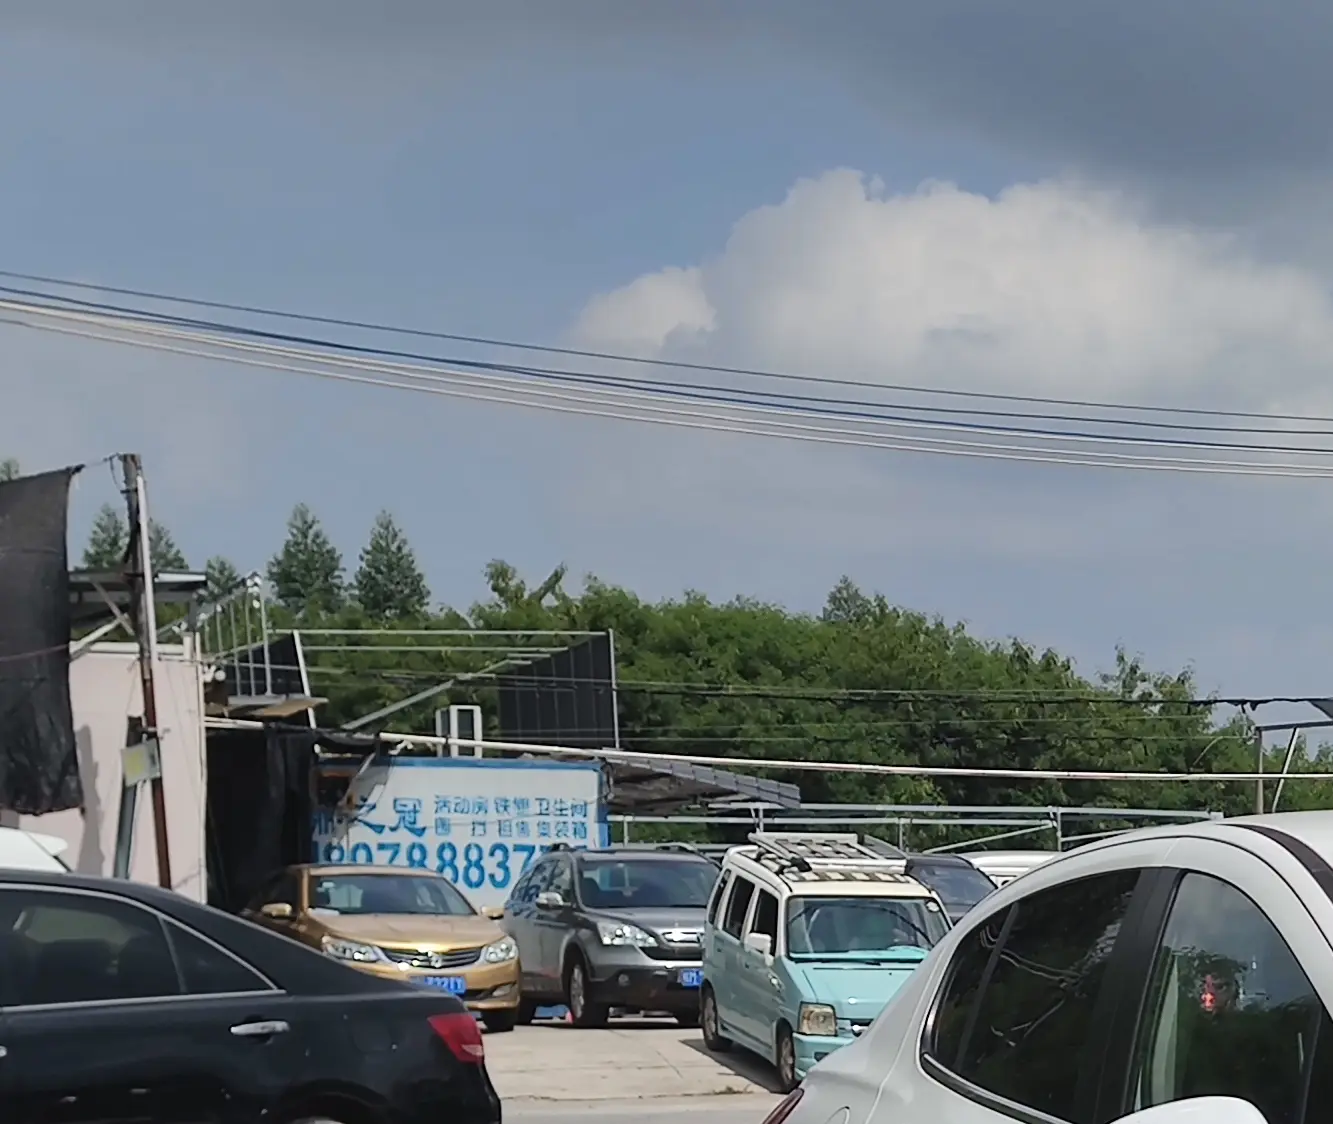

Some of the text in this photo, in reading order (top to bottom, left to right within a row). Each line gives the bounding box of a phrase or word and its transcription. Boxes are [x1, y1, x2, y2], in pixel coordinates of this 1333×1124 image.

[434, 794, 489, 815] 活动房
[535, 797, 588, 817] 卫生间
